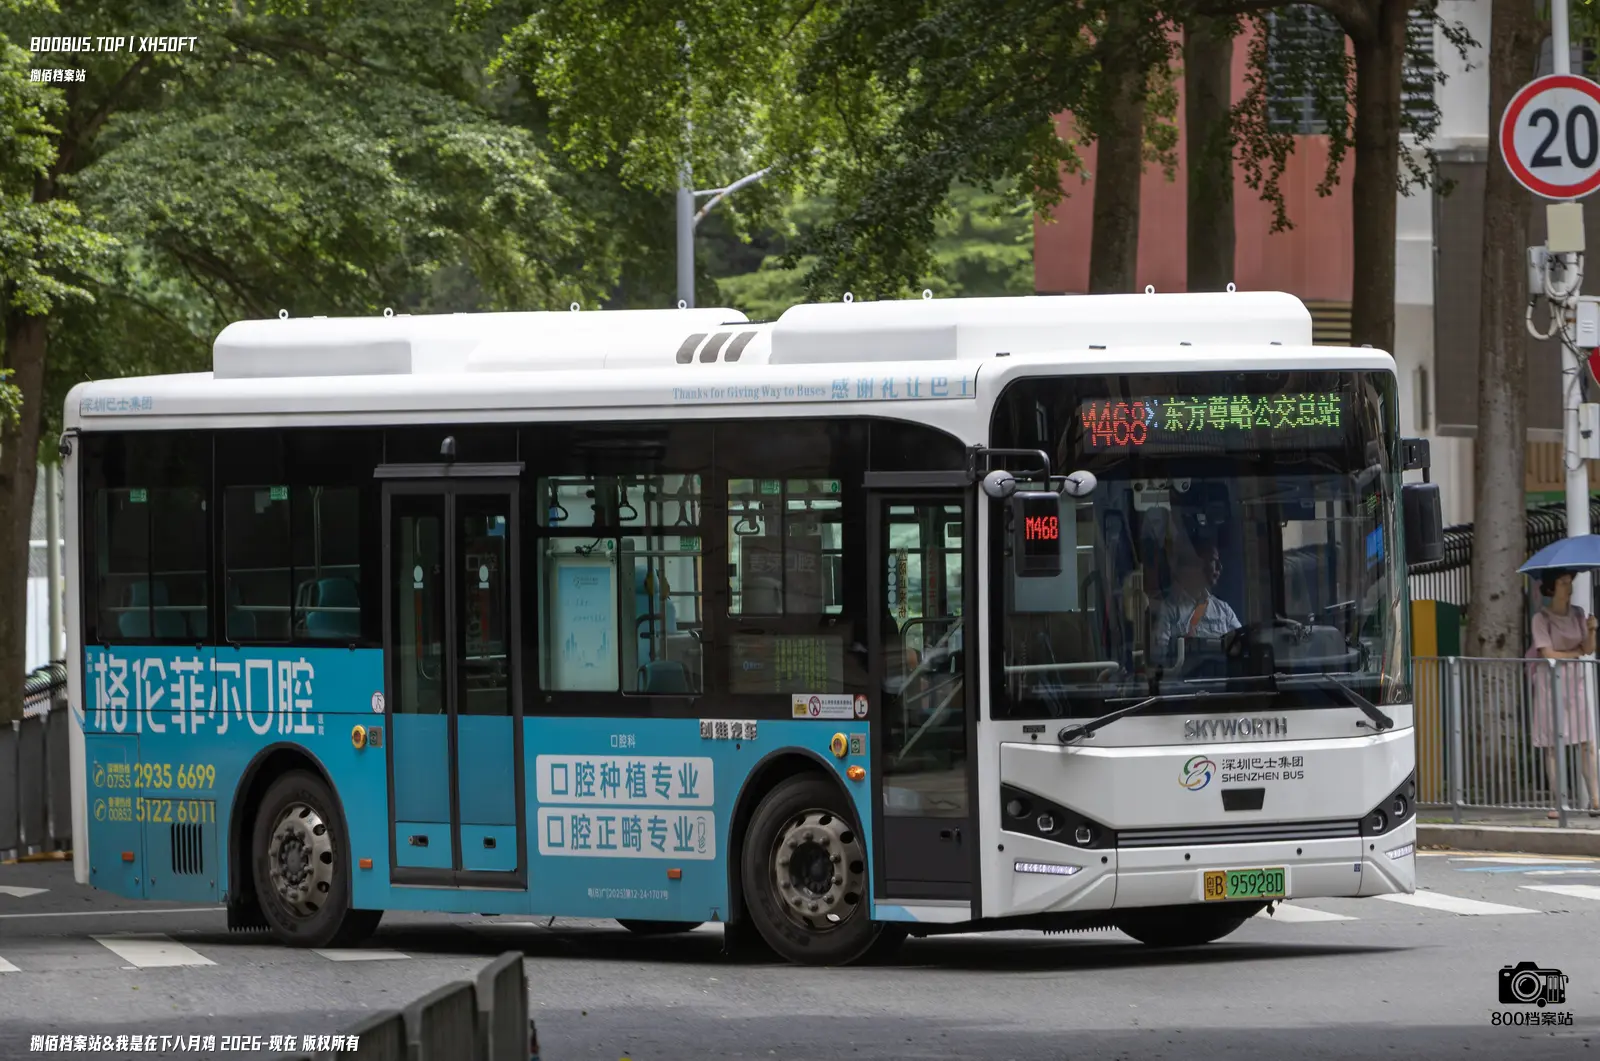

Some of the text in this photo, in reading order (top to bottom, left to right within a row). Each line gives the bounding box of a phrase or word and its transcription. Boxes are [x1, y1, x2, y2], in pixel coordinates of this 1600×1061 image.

[1528, 104, 1599, 169] 20
[672, 384, 826, 400] Thanks for Giving Way to Buses
[831, 375, 974, 399] 感谢礼让巴士
[1025, 516, 1059, 540] M468
[94, 653, 315, 735] 格伦菲尔口腔
[700, 720, 757, 741] 创维汽车
[1184, 716, 1288, 739] SKYWORTH
[610, 734, 636, 748] 口腔科
[1221, 755, 1304, 771] 深圳巴士集团
[107, 762, 216, 789] 0755 2935 6699
[550, 761, 699, 800] 口腔种植专业
[1221, 770, 1304, 783] SHENZHEN BUS
[135, 797, 173, 822] 5122
[177, 799, 215, 823] 6011
[546, 814, 695, 853] 口腔正畸专业
[1206, 872, 1283, 896] 粤B 95928D
